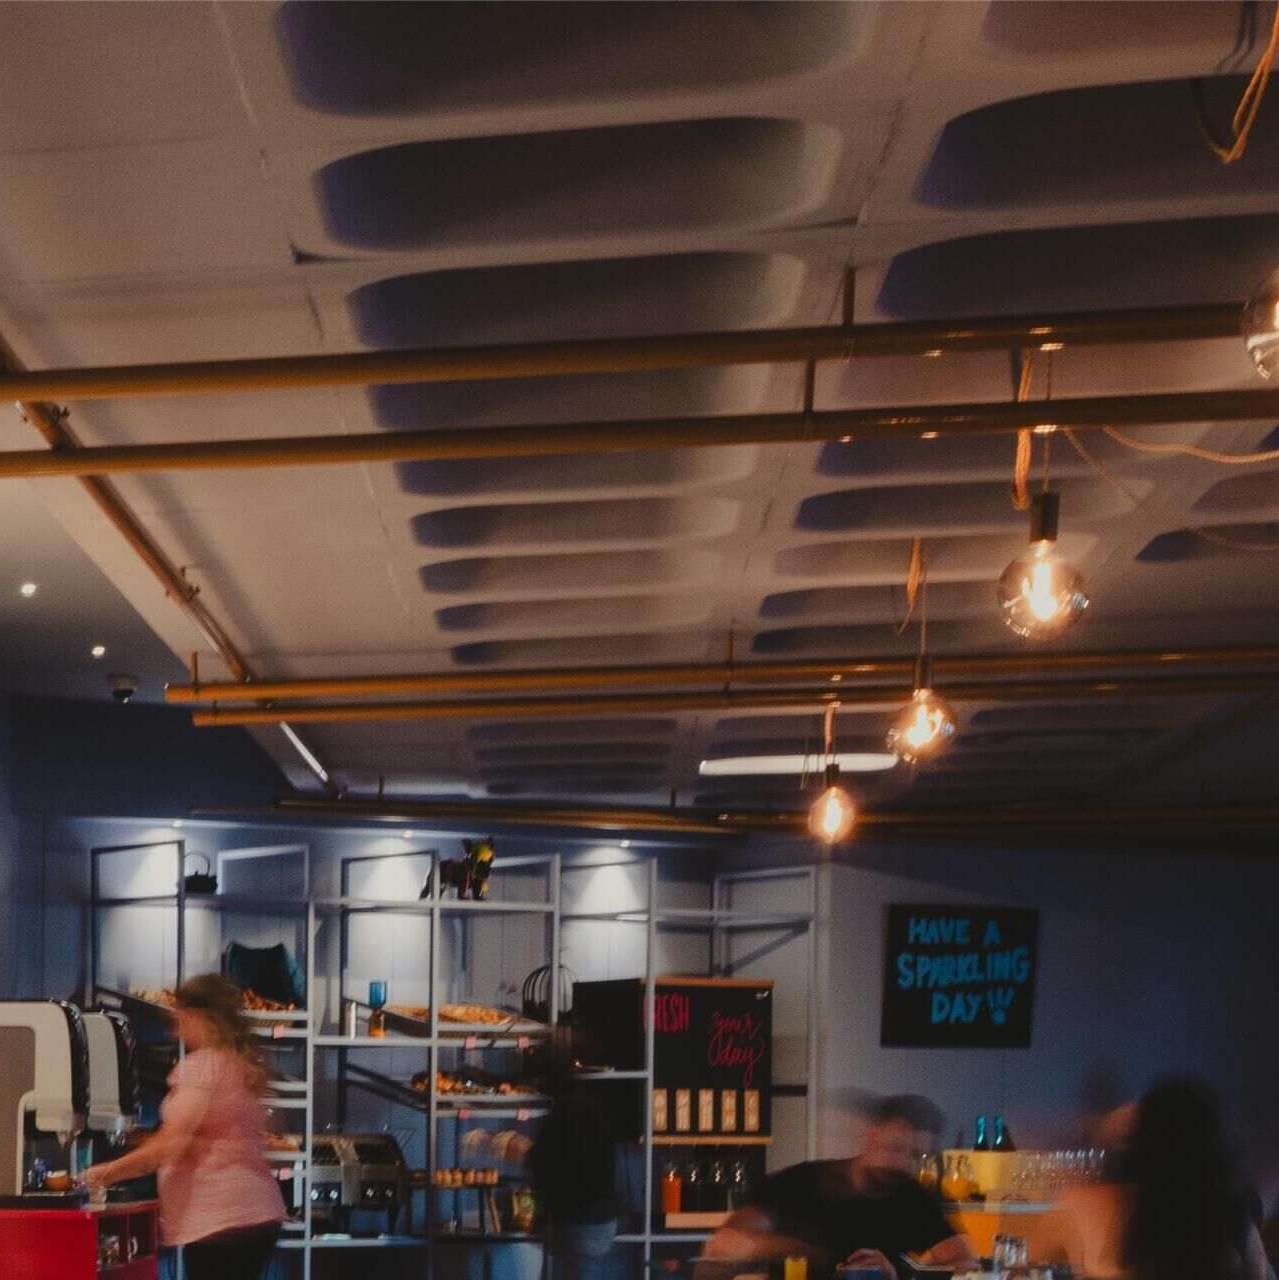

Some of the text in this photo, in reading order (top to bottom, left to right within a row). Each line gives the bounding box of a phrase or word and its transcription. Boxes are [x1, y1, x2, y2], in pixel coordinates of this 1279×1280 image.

[908, 917, 1002, 946] HAVE A
[897, 946, 1031, 989] SPARKLING
[643, 992, 690, 1033] RESH
